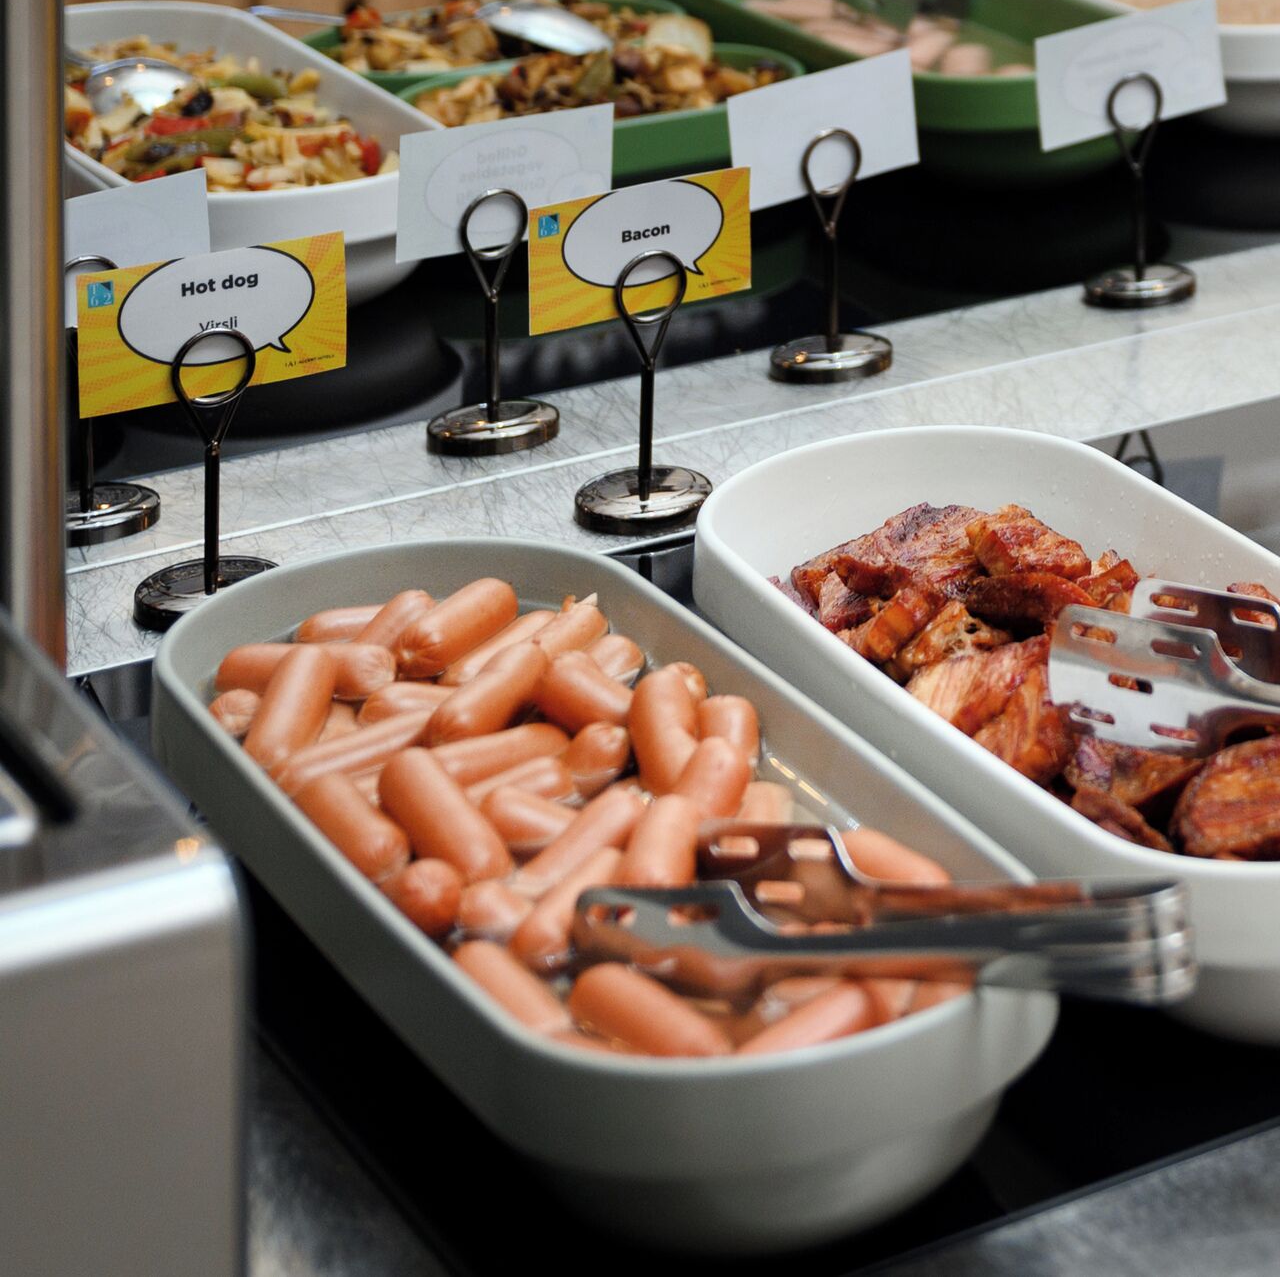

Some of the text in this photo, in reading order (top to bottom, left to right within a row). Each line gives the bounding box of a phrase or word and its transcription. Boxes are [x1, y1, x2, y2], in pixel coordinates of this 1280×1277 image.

[621, 224, 671, 243] Bacon
[181, 273, 259, 297] Hot dog
